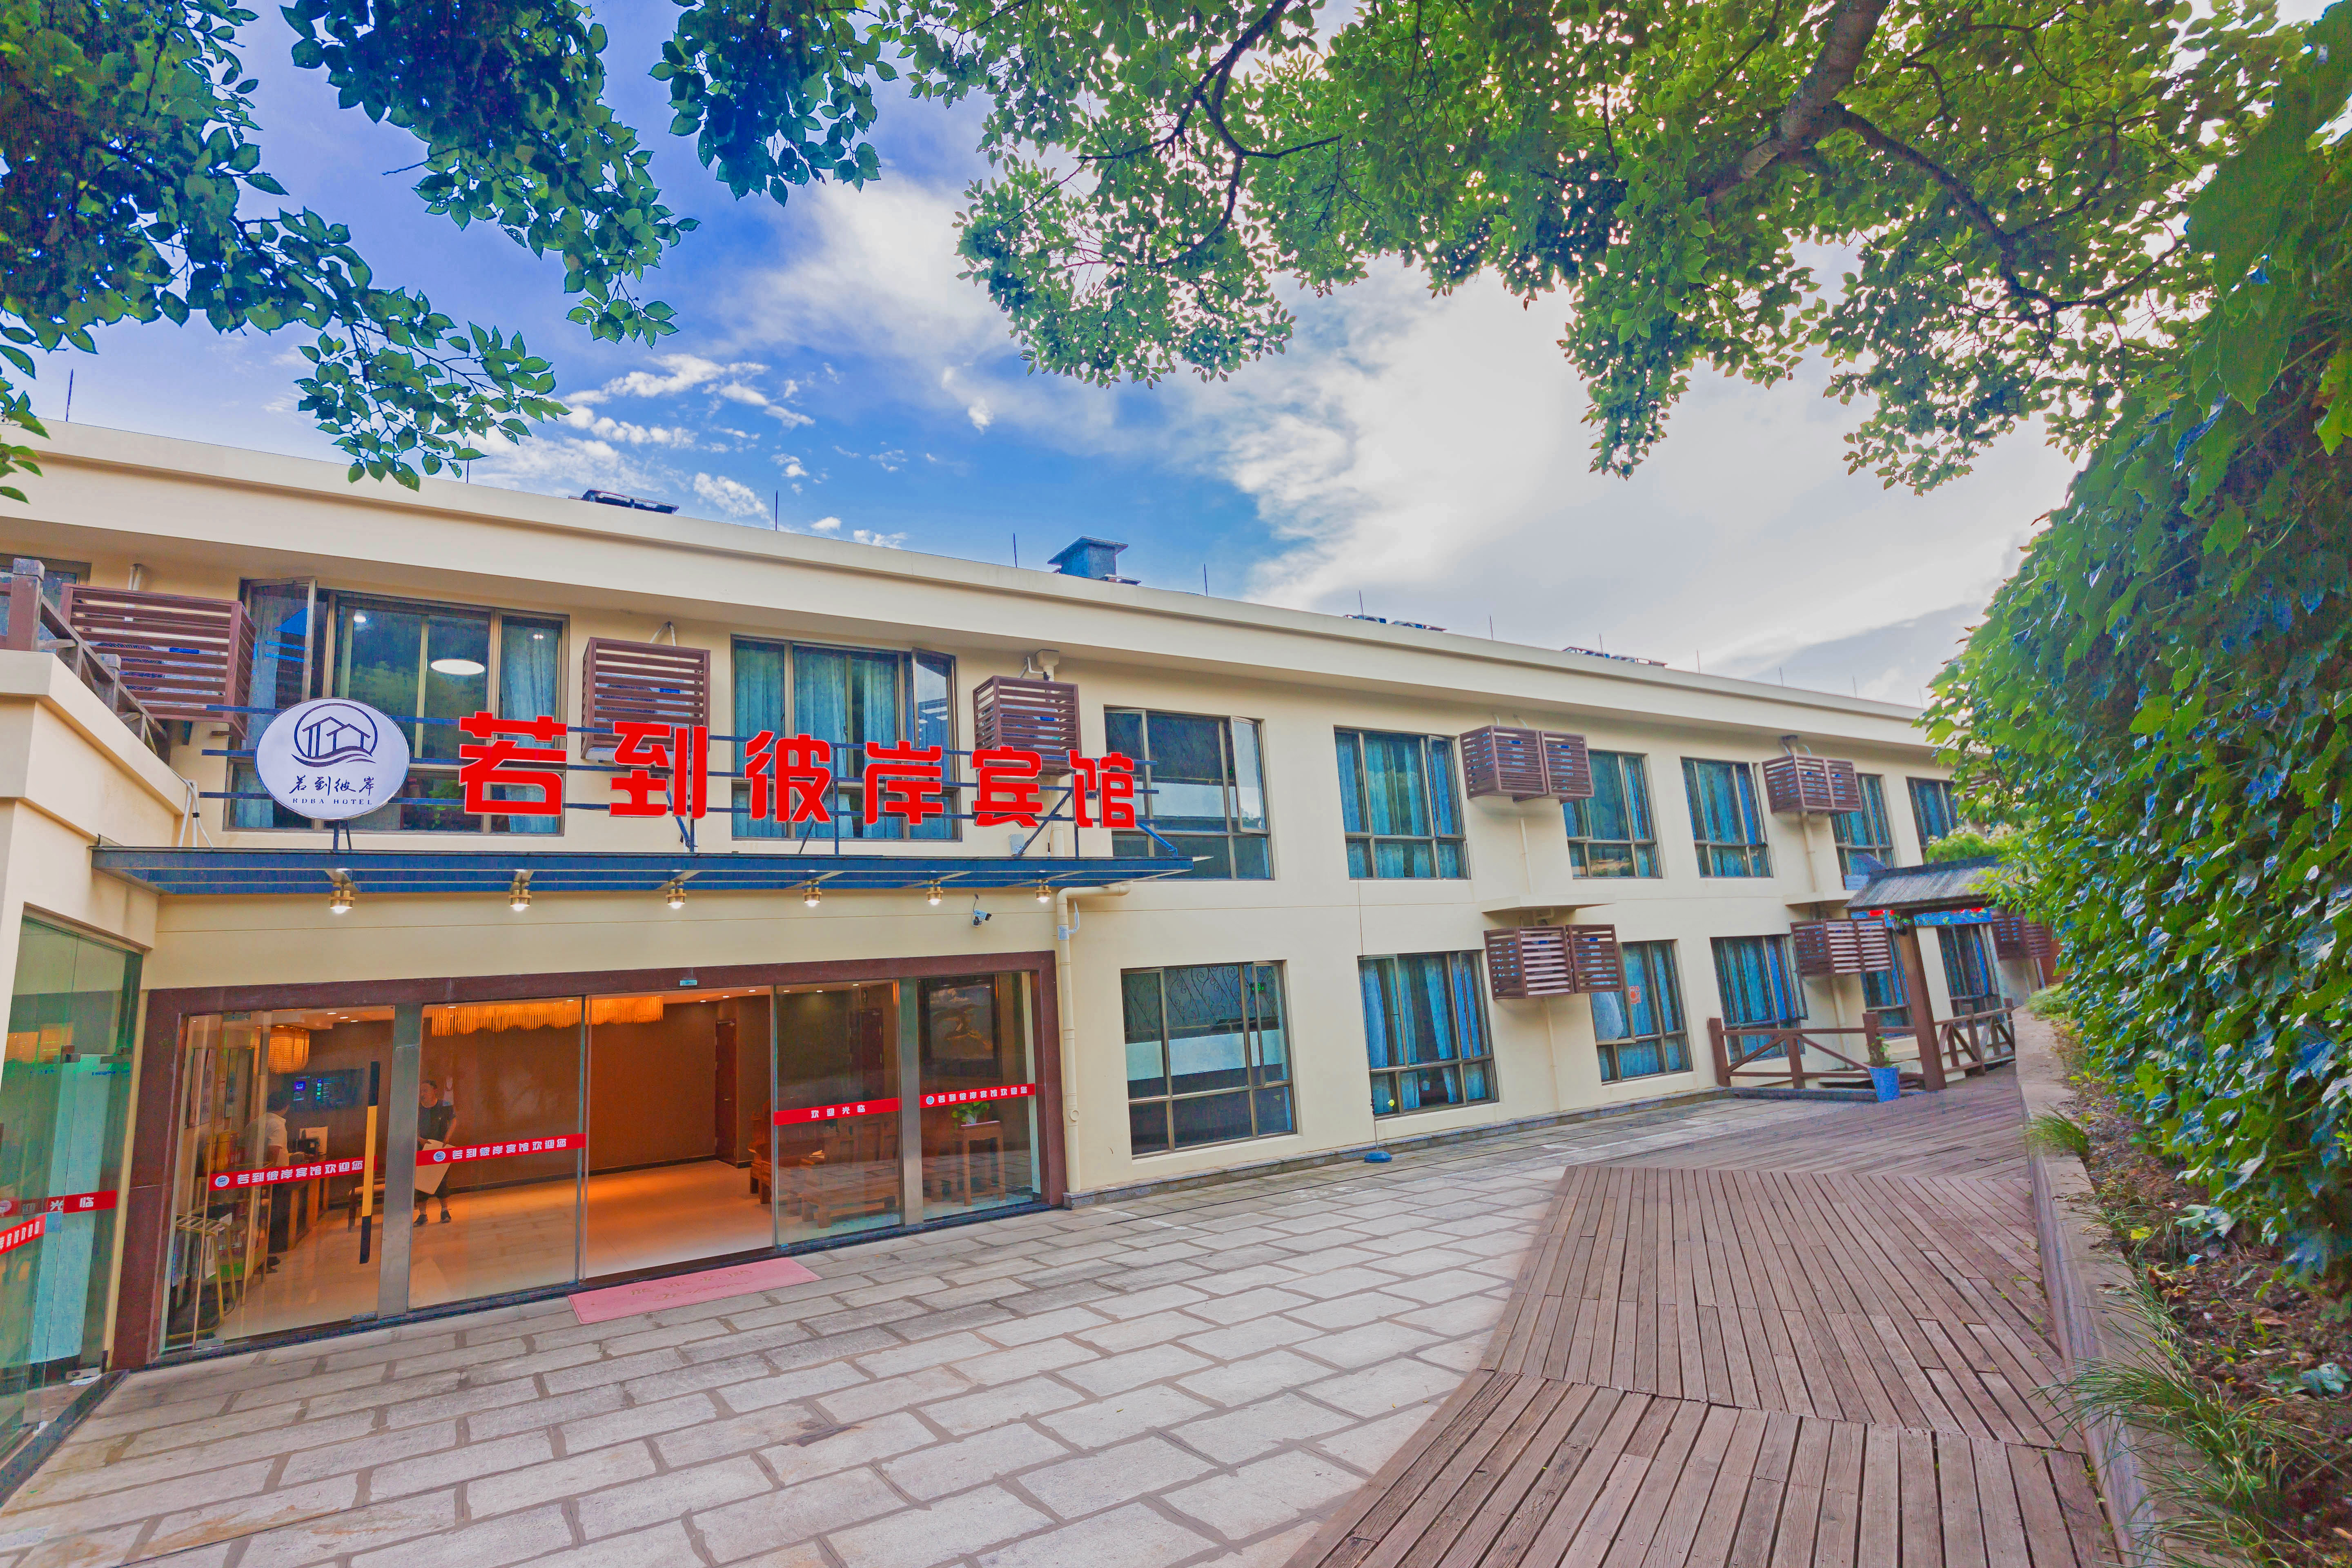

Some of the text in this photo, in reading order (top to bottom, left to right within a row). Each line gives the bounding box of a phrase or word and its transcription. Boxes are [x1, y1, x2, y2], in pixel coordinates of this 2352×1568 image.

[459, 711, 1136, 829] 若到彼岸宾馆
[289, 775, 374, 796] 若到彼岸
[938, 1087, 1027, 1103] 若到彼岸宾馆欢迎您
[811, 1105, 865, 1118] 欢迎光临
[452, 1138, 567, 1159] 若到彼岸宾馆欢迎您
[237, 1160, 363, 1184] 若到彼岸宾馆欢迎您
